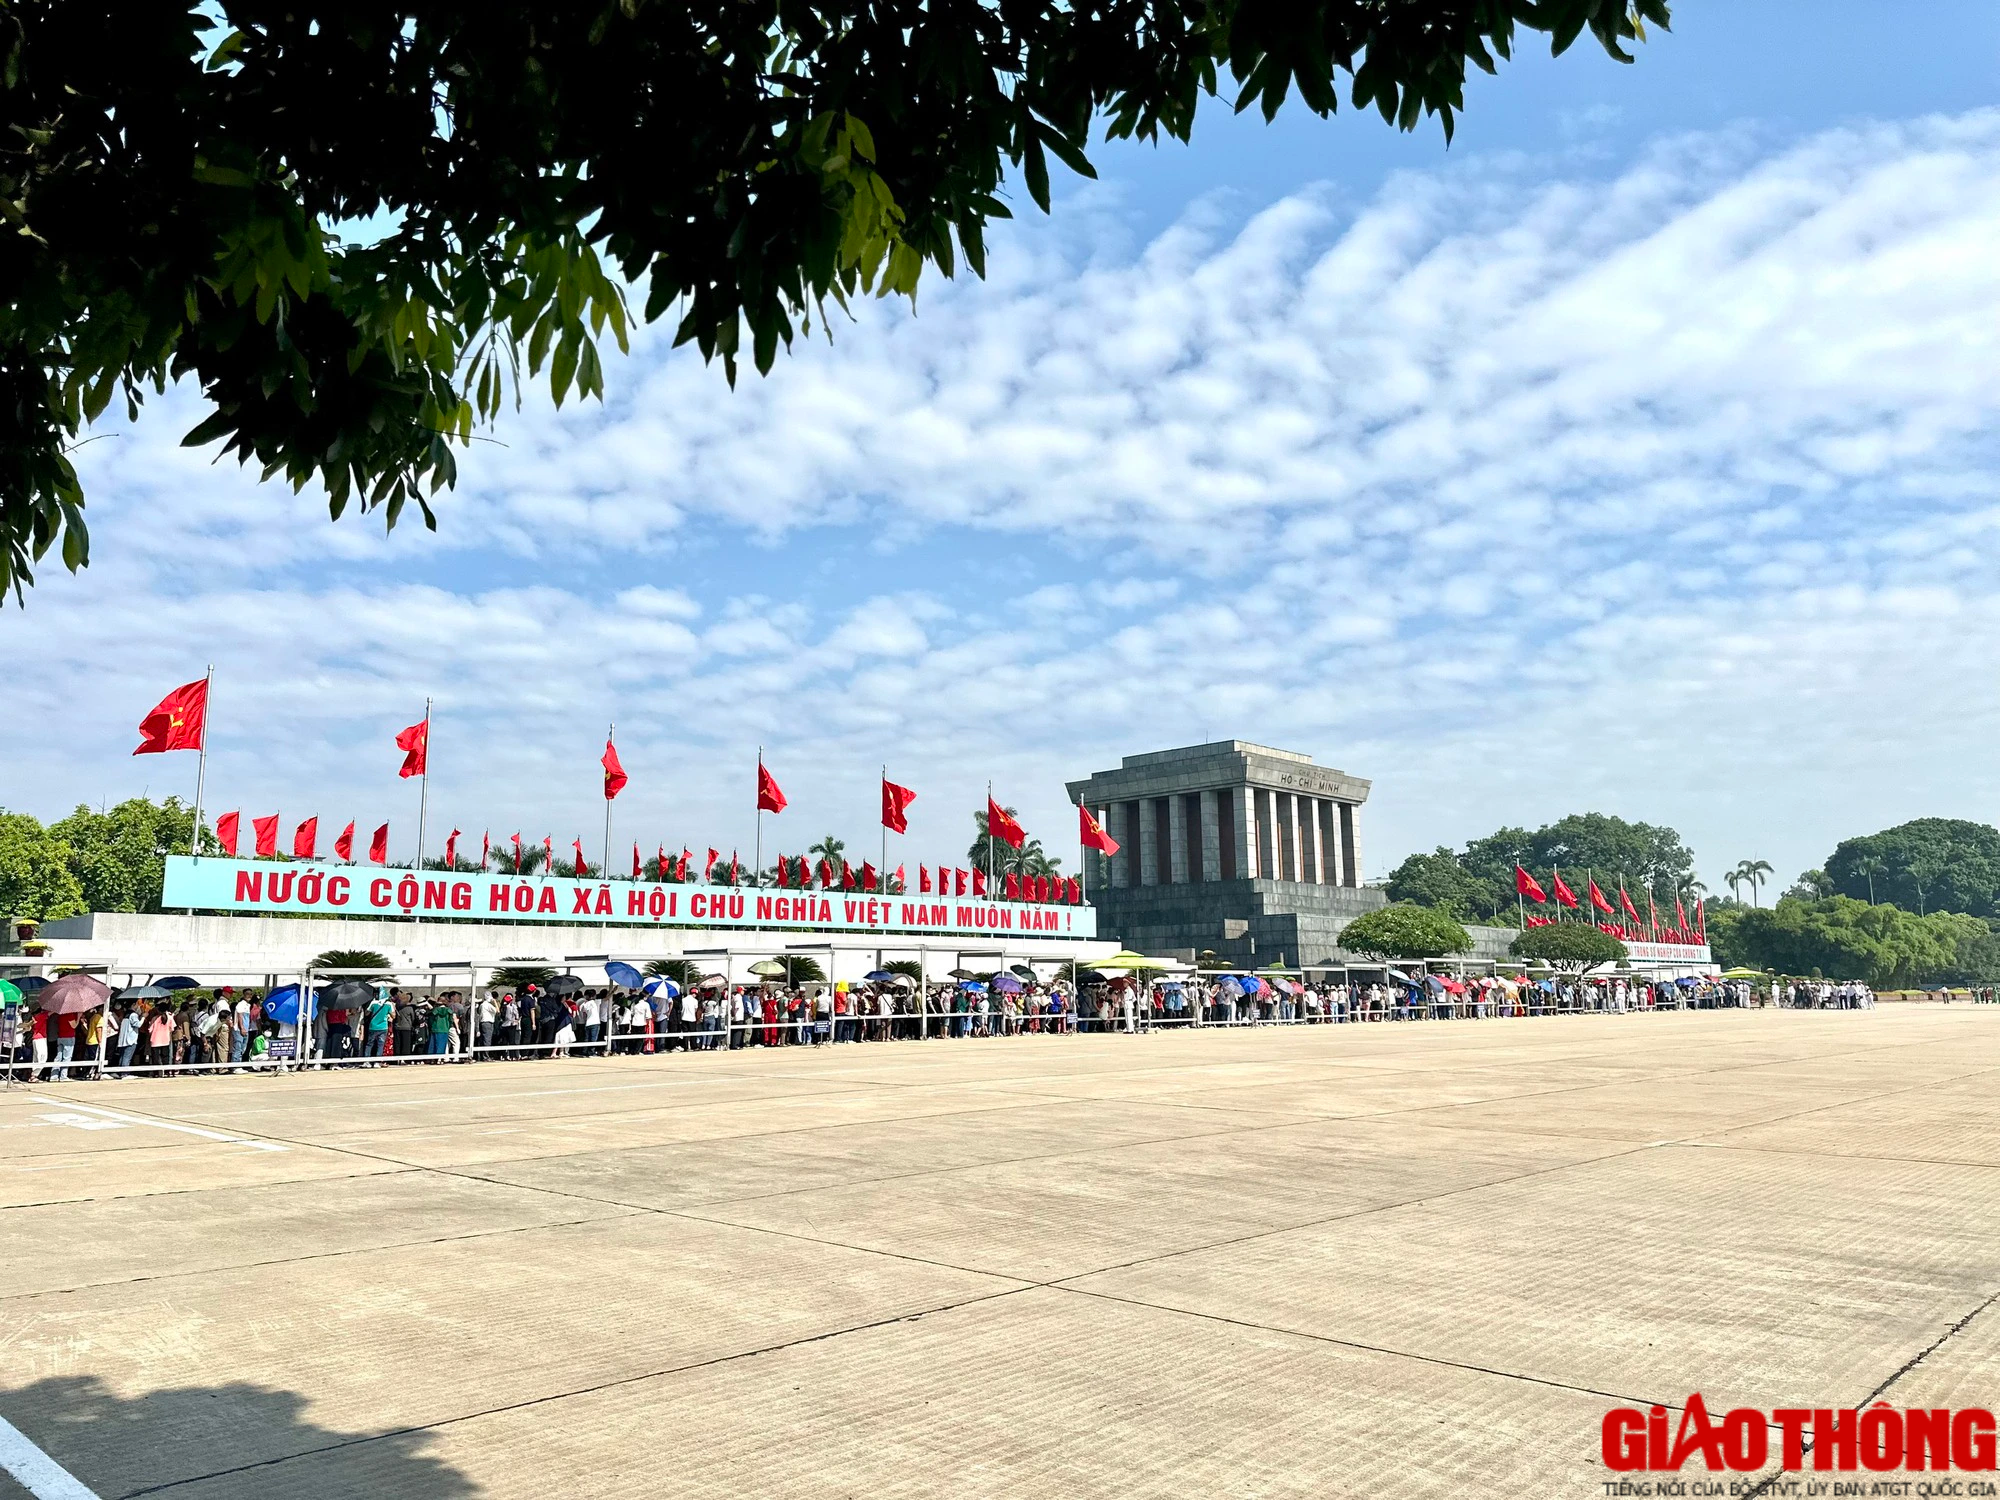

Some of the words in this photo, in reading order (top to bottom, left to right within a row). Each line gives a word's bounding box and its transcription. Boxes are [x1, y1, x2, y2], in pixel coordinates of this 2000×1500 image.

[235, 867, 350, 906] NƯỚC
[369, 873, 472, 914] CỘNG
[489, 879, 557, 914] HÒA
[571, 883, 613, 915] XÃ
[628, 886, 677, 922] HỘI
[690, 887, 744, 919] CHỦ
[756, 894, 832, 923] NGHĨA
[844, 896, 892, 928] VIỆT
[901, 902, 948, 926] NAM
[956, 902, 1012, 929] MUÔN
[1019, 904, 1059, 931] NĂM
